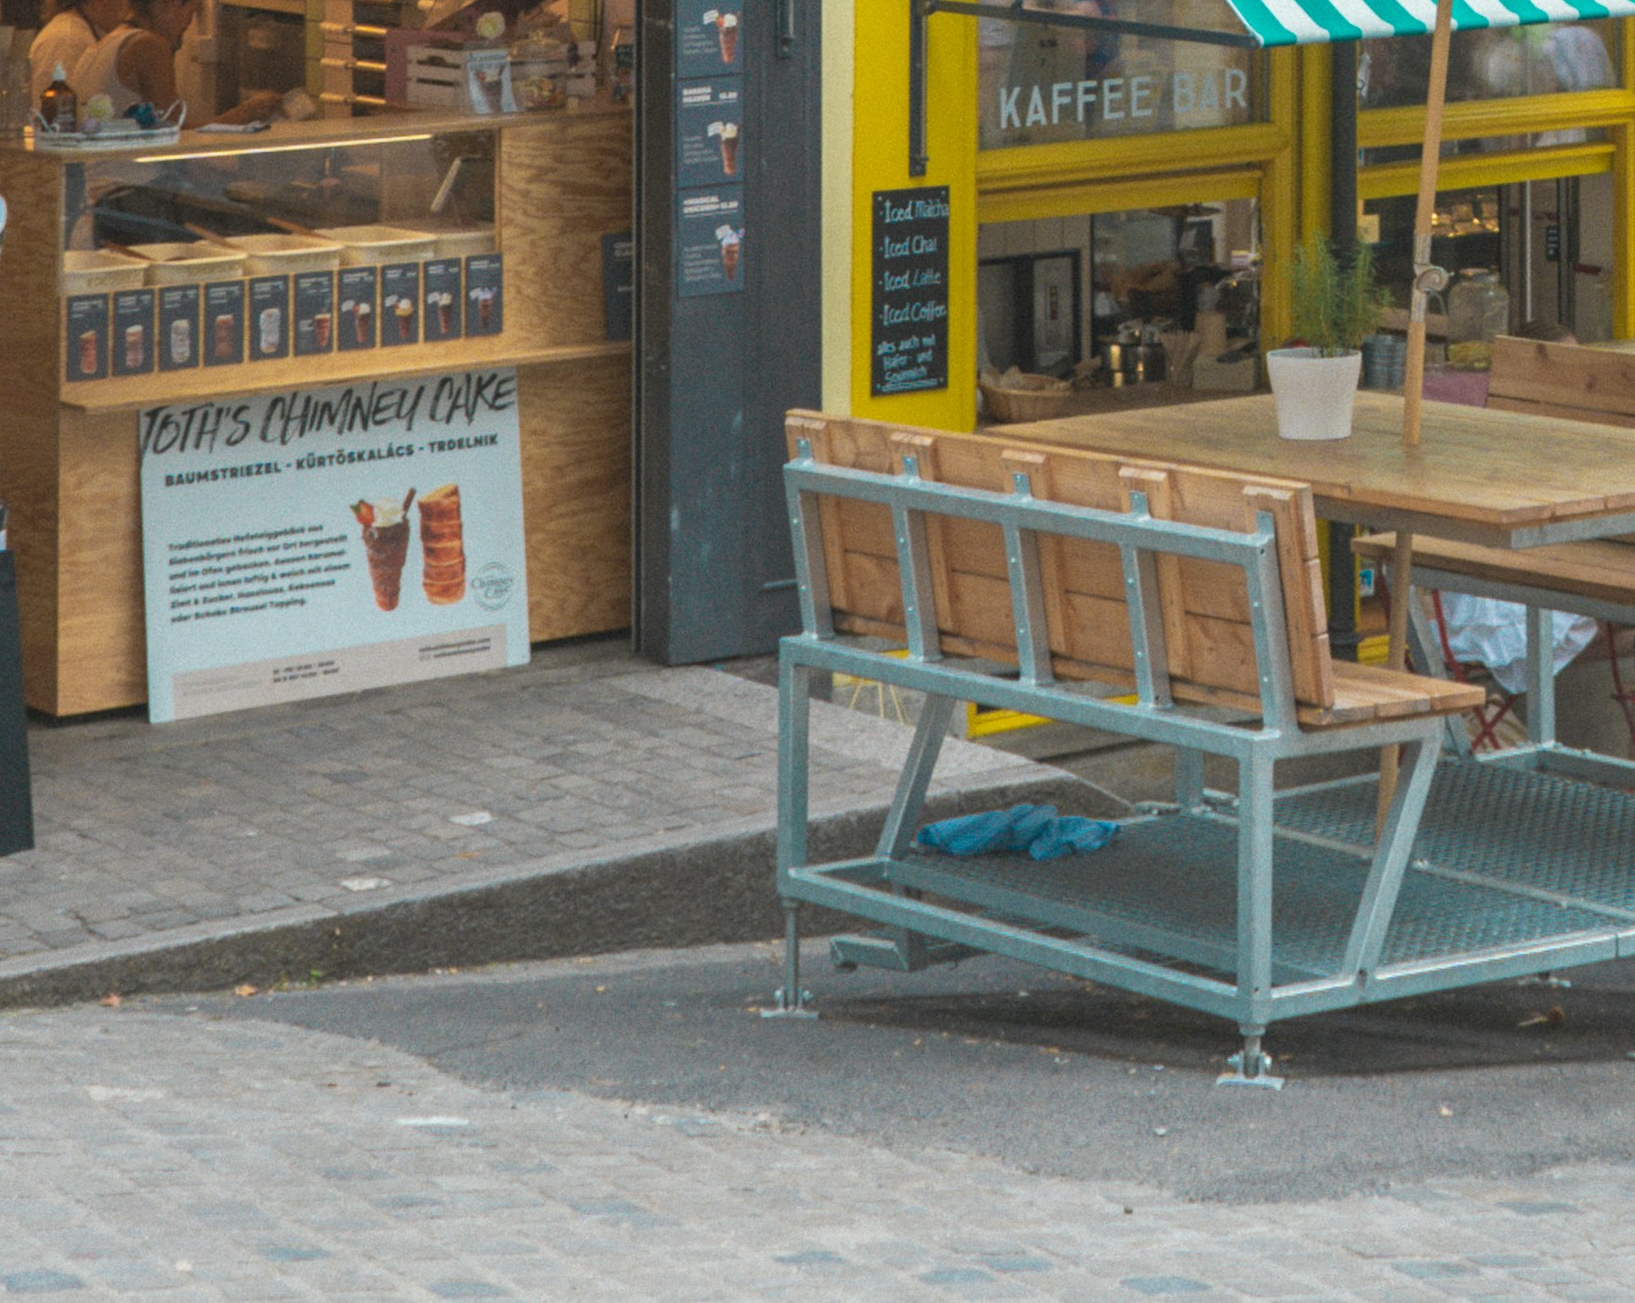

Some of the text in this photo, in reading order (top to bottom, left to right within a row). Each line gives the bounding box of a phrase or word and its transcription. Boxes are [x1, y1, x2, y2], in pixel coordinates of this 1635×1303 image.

[1000, 68, 1248, 129] KAFFEE BAR
[884, 199, 913, 223] Iced
[883, 235, 910, 259] Iced
[883, 269, 910, 292] Iced
[883, 302, 911, 327] Iced
[262, 382, 426, 445] CHIMNEY
[428, 371, 517, 426] CAKE
[165, 461, 282, 487] BAUMSTRIEZEL
[428, 432, 499, 455] TRDELNIK
